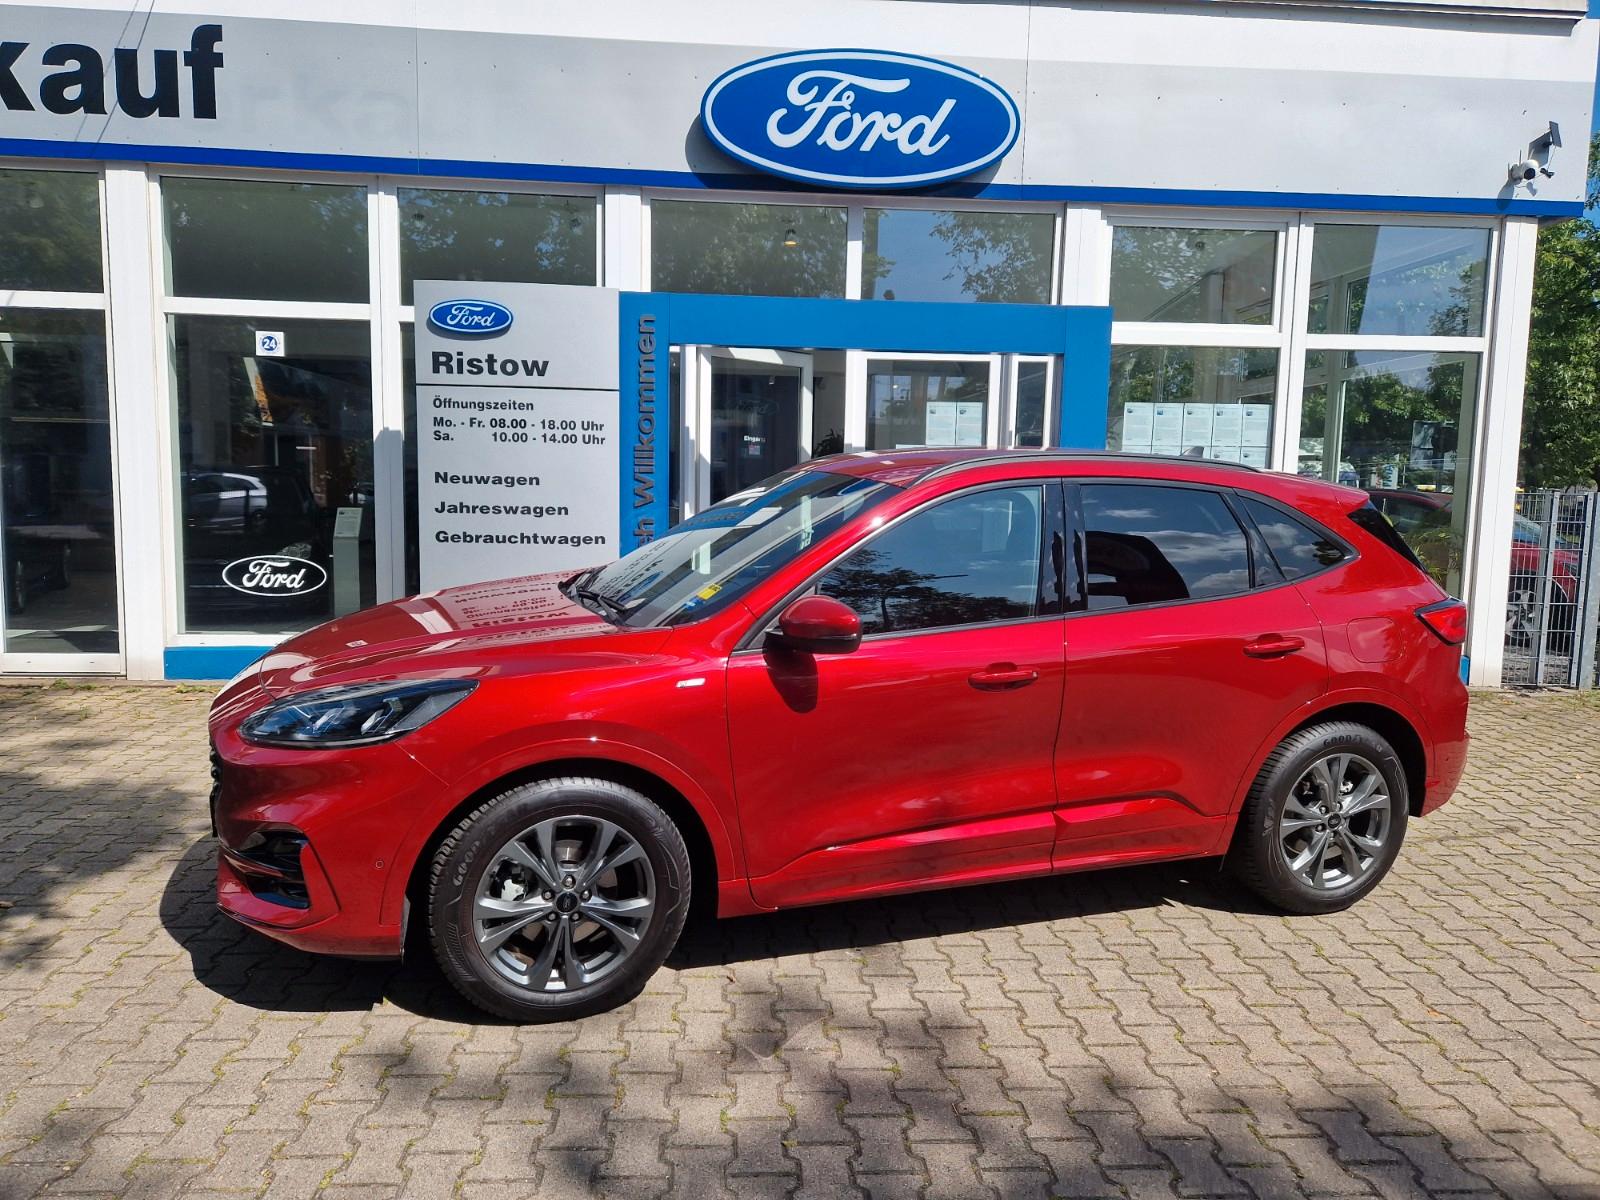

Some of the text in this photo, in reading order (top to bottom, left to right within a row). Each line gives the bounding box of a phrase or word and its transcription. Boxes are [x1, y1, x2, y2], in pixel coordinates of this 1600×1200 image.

[0, 24, 224, 119] kauf
[766, 70, 957, 156] Ford
[446, 304, 495, 327] Ford
[262, 338, 277, 349] 24
[432, 351, 549, 377] Ristow
[433, 395, 534, 411] Öffnungszeiten
[633, 314, 656, 509] Willkommen
[433, 416, 457, 428] Mo.
[469, 417, 486, 429] Fr.
[489, 418, 527, 429] 08.00
[540, 419, 577, 431] 18.00
[581, 420, 605, 432] Uhr
[433, 430, 455, 441] Sa.
[492, 432, 528, 443] 10.00
[541, 433, 578, 445] 14.00
[582, 434, 606, 446] Uhr
[434, 471, 541, 488] Neuwagen
[434, 501, 569, 518] Jahreswagen
[435, 530, 606, 547] Gebrauchtwagen
[242, 560, 306, 589] Ford
